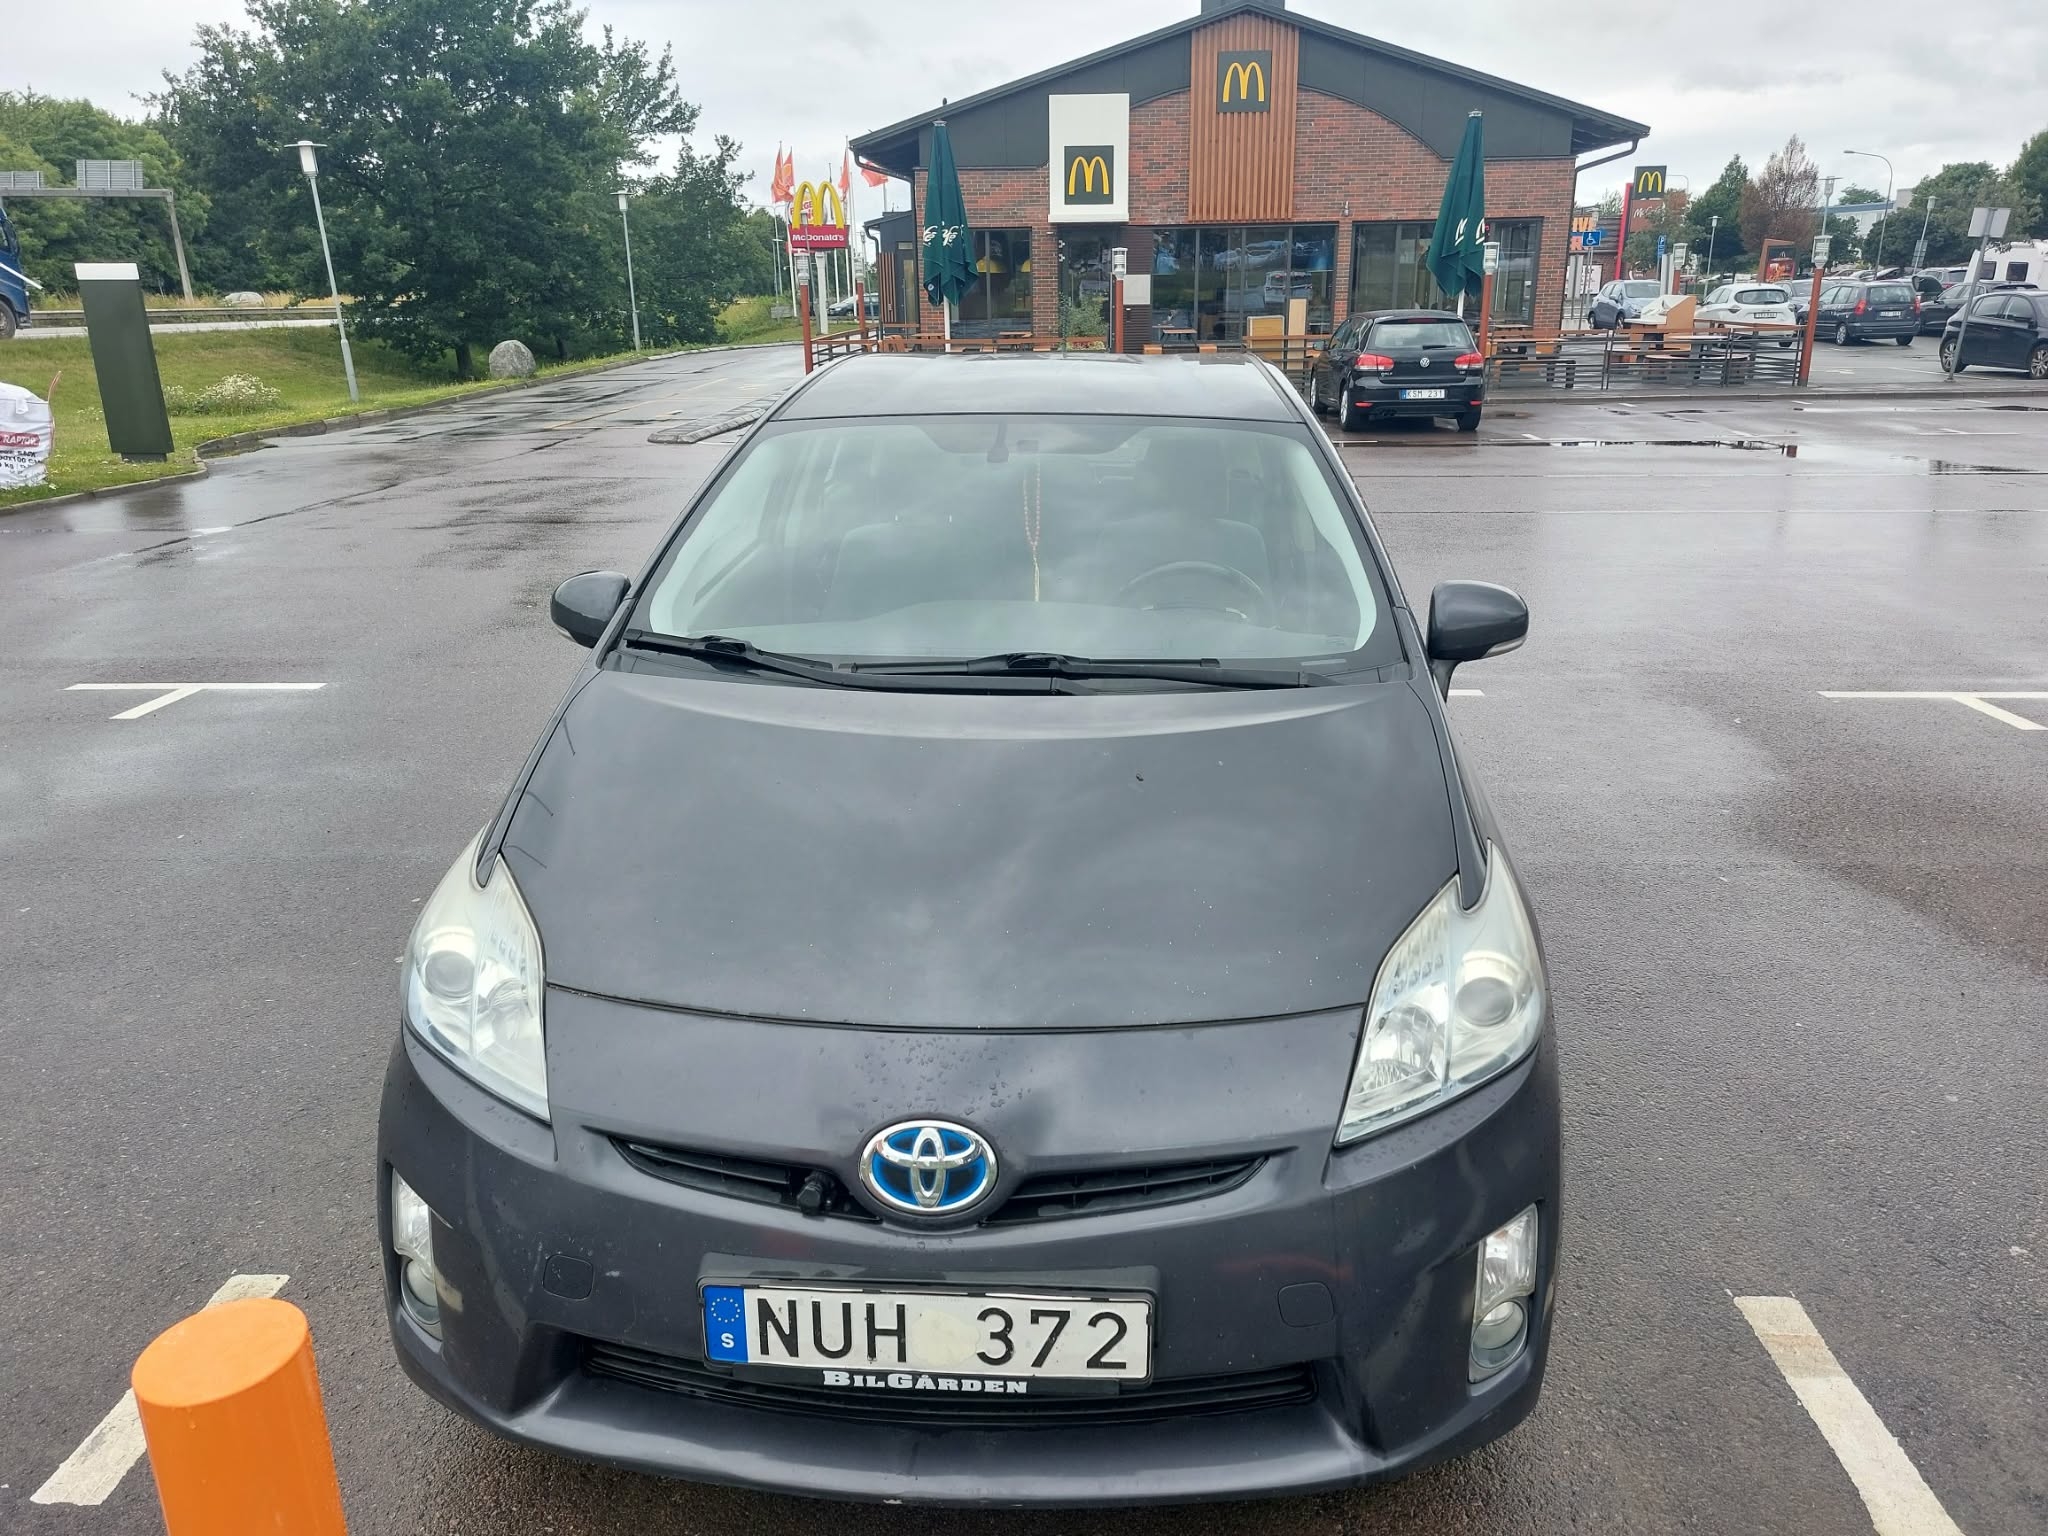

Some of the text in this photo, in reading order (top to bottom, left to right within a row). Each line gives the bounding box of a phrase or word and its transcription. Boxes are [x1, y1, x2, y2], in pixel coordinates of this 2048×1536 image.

[1407, 389, 1442, 398] KSM 231
[721, 1332, 735, 1348] S
[757, 1298, 1128, 1370] NUH 372
